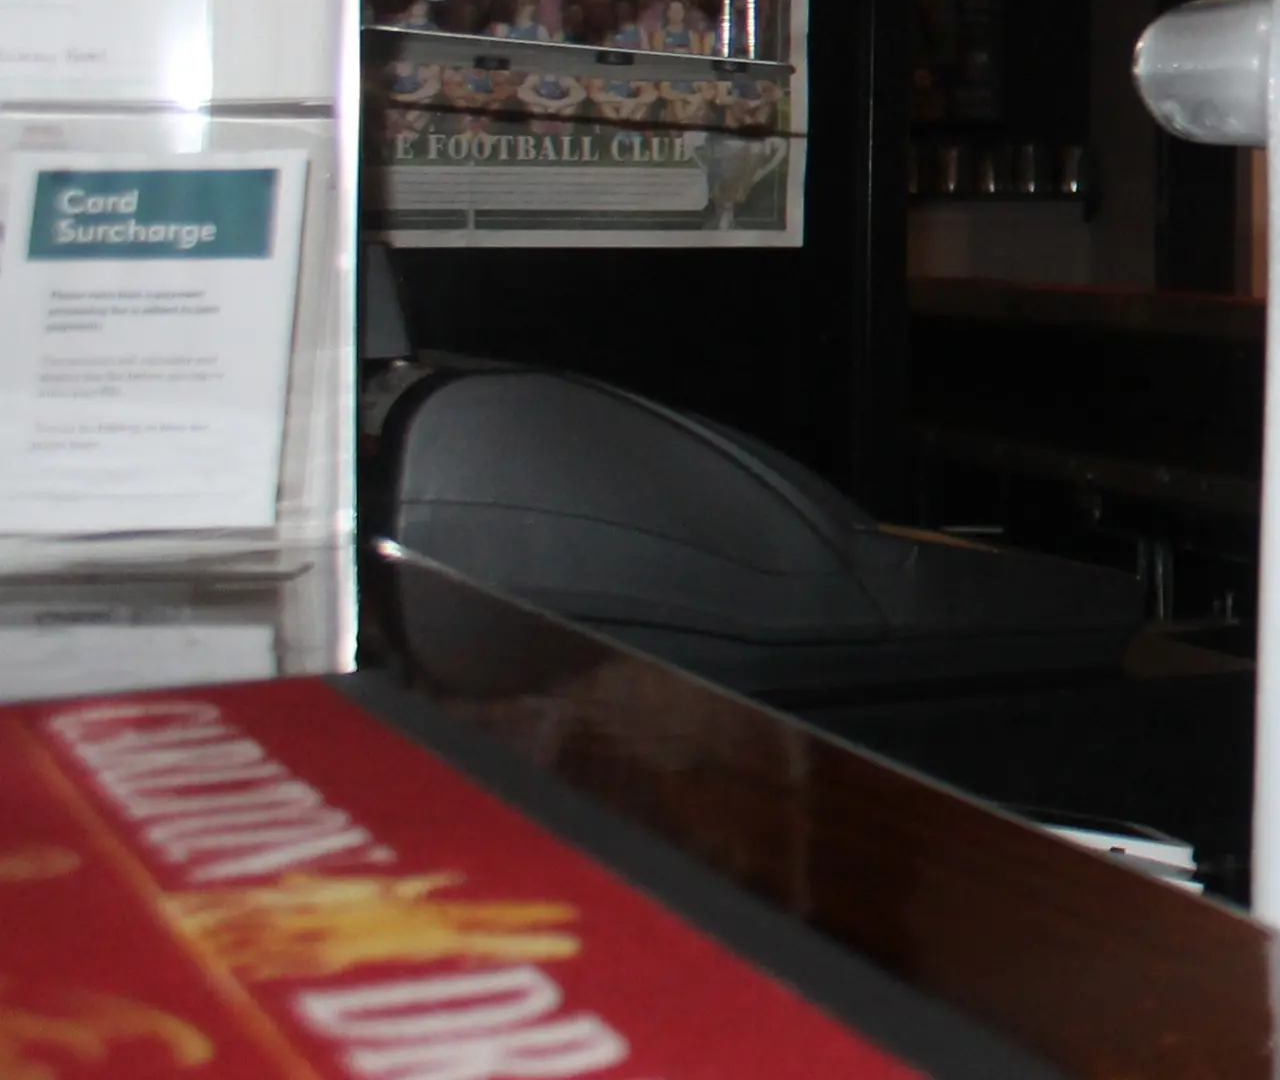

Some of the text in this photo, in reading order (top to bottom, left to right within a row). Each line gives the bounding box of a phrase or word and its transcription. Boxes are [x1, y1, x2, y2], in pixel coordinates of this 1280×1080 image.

[428, 133, 599, 161] FOOTBALL
[610, 135, 692, 163] CLUB
[59, 188, 139, 215] Card
[55, 218, 218, 250] Surcharge
